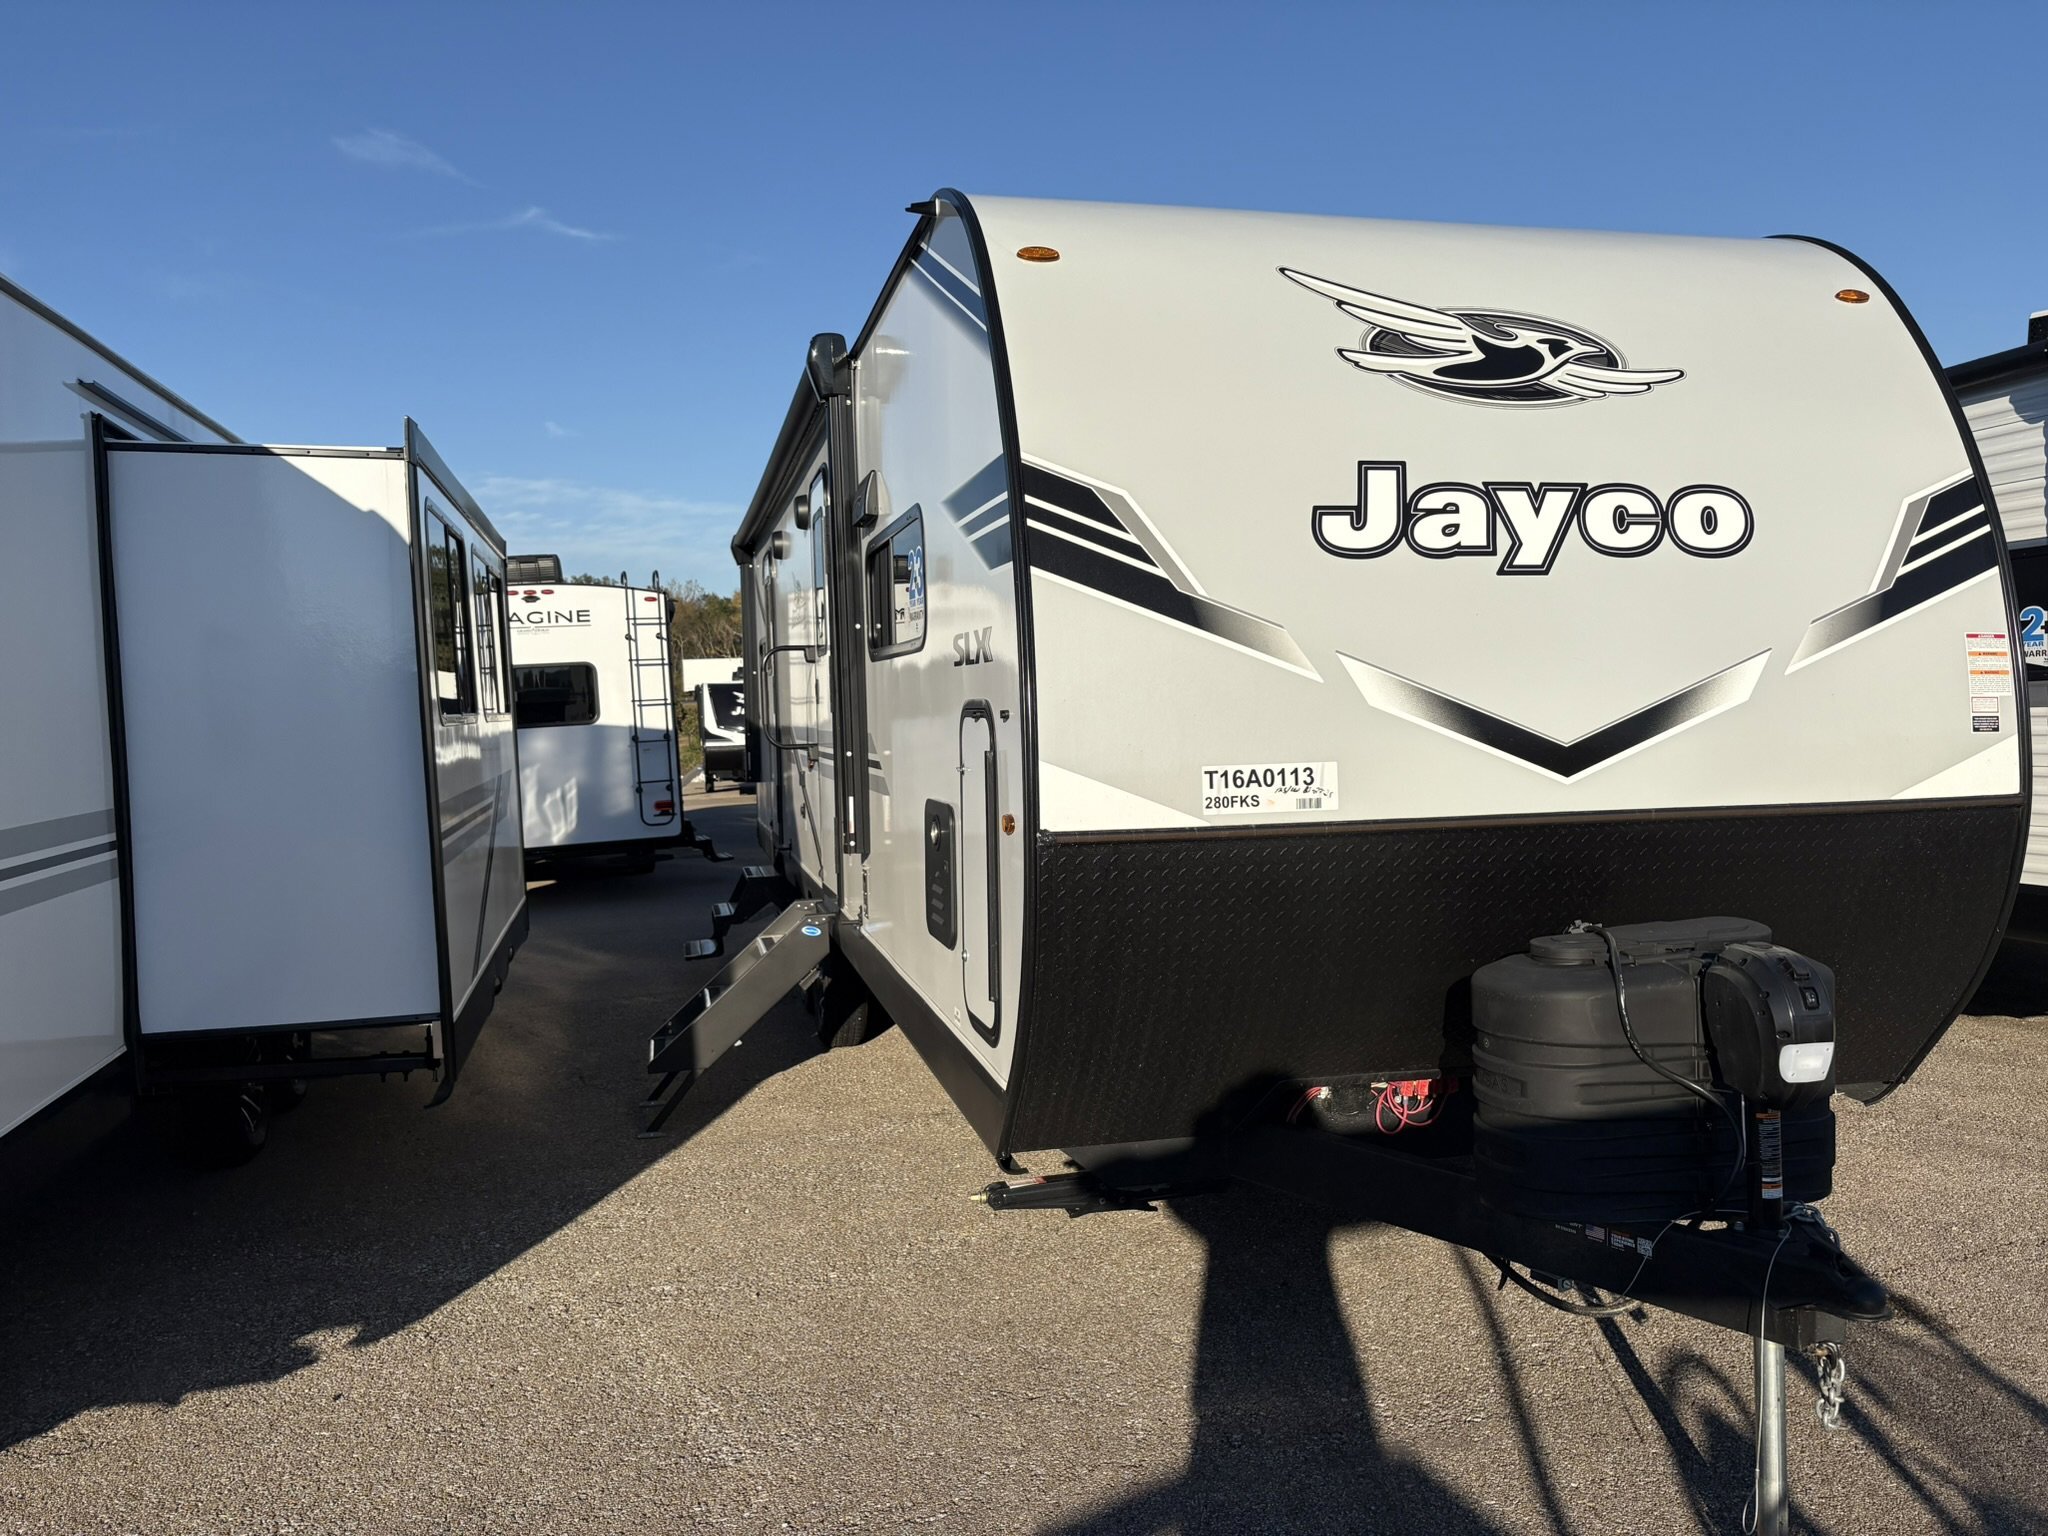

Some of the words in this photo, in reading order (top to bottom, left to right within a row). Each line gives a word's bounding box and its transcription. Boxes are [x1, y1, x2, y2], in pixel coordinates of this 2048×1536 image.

[1311, 460, 1755, 576] Jayco
[1204, 767, 1314, 789] T16A0113
[1205, 795, 1260, 809] 280FKS
